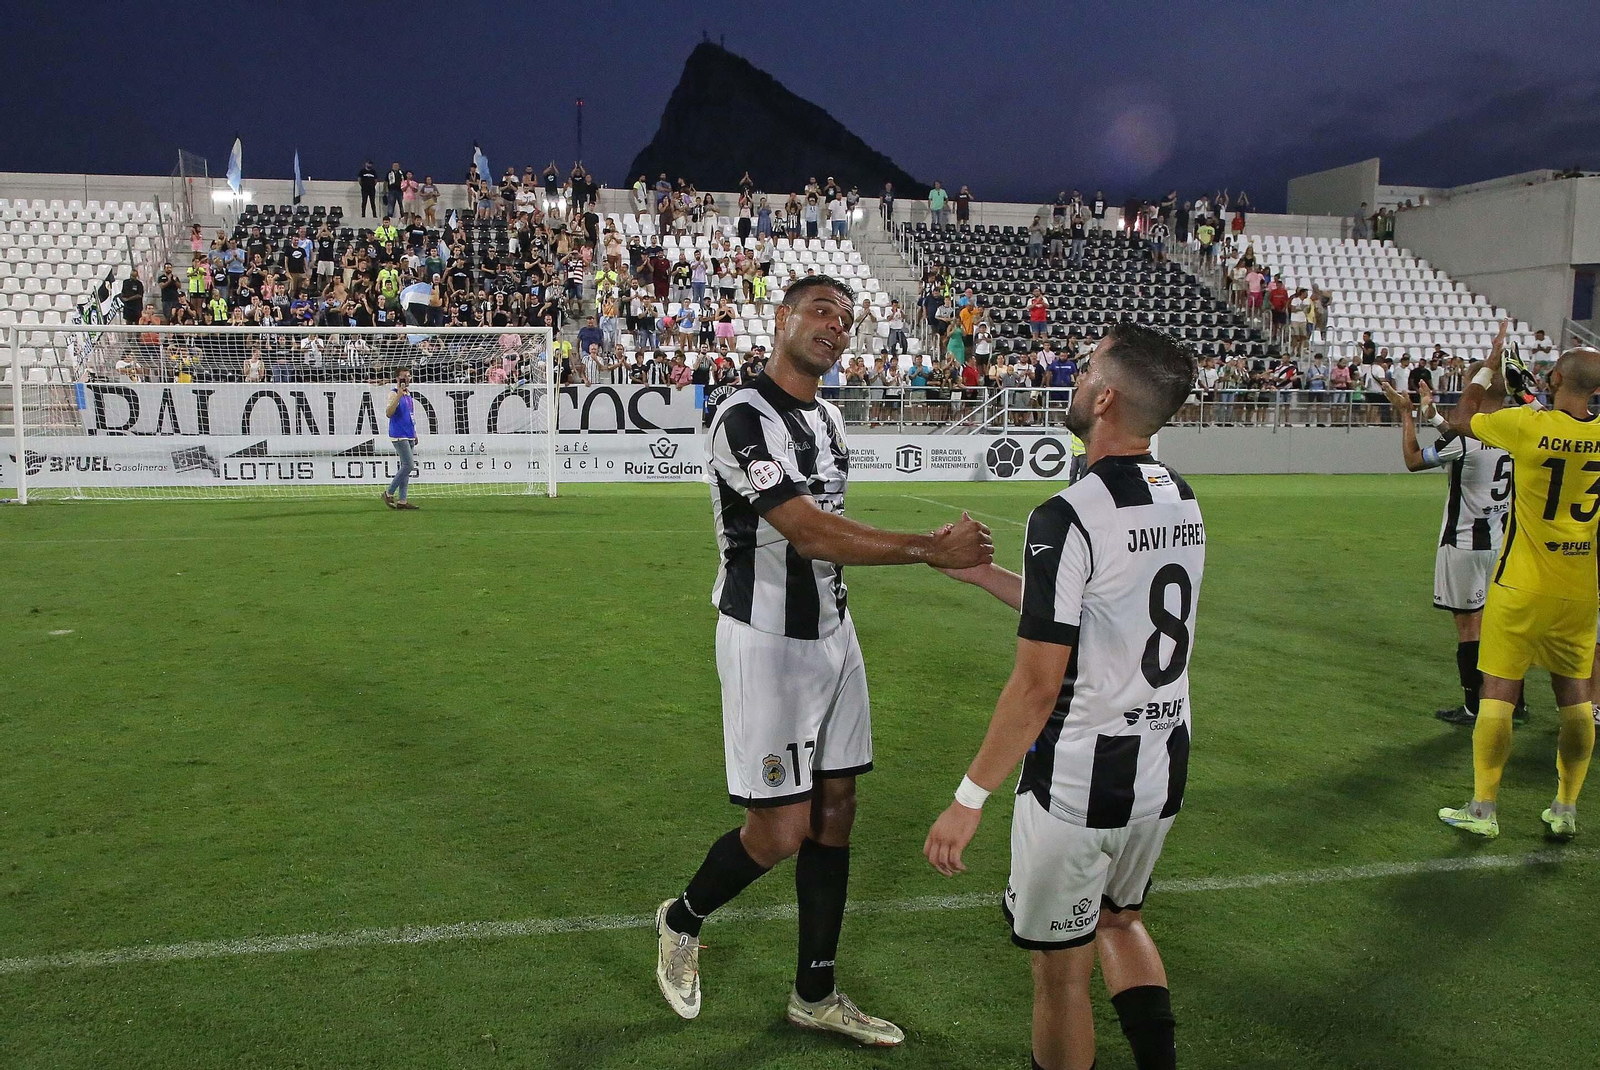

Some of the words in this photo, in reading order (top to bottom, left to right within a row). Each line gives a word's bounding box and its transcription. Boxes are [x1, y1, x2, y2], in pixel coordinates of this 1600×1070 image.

[449, 442, 485, 453] café
[50, 456, 112, 472] BFUEL
[113, 462, 168, 473] Gasolineras
[423, 458, 512, 470] modelo
[624, 461, 655, 475] Ruiz
[658, 460, 703, 475] Galán
[895, 449, 922, 468] ITS
[224, 462, 314, 480] LOTUS
[1491, 455, 1511, 501] 5
[1540, 458, 1600, 522] 13
[1127, 526, 1167, 553] JAVI
[1141, 563, 1192, 689] 8
[786, 740, 815, 786] 17
[1050, 918, 1073, 931] Ruiz
